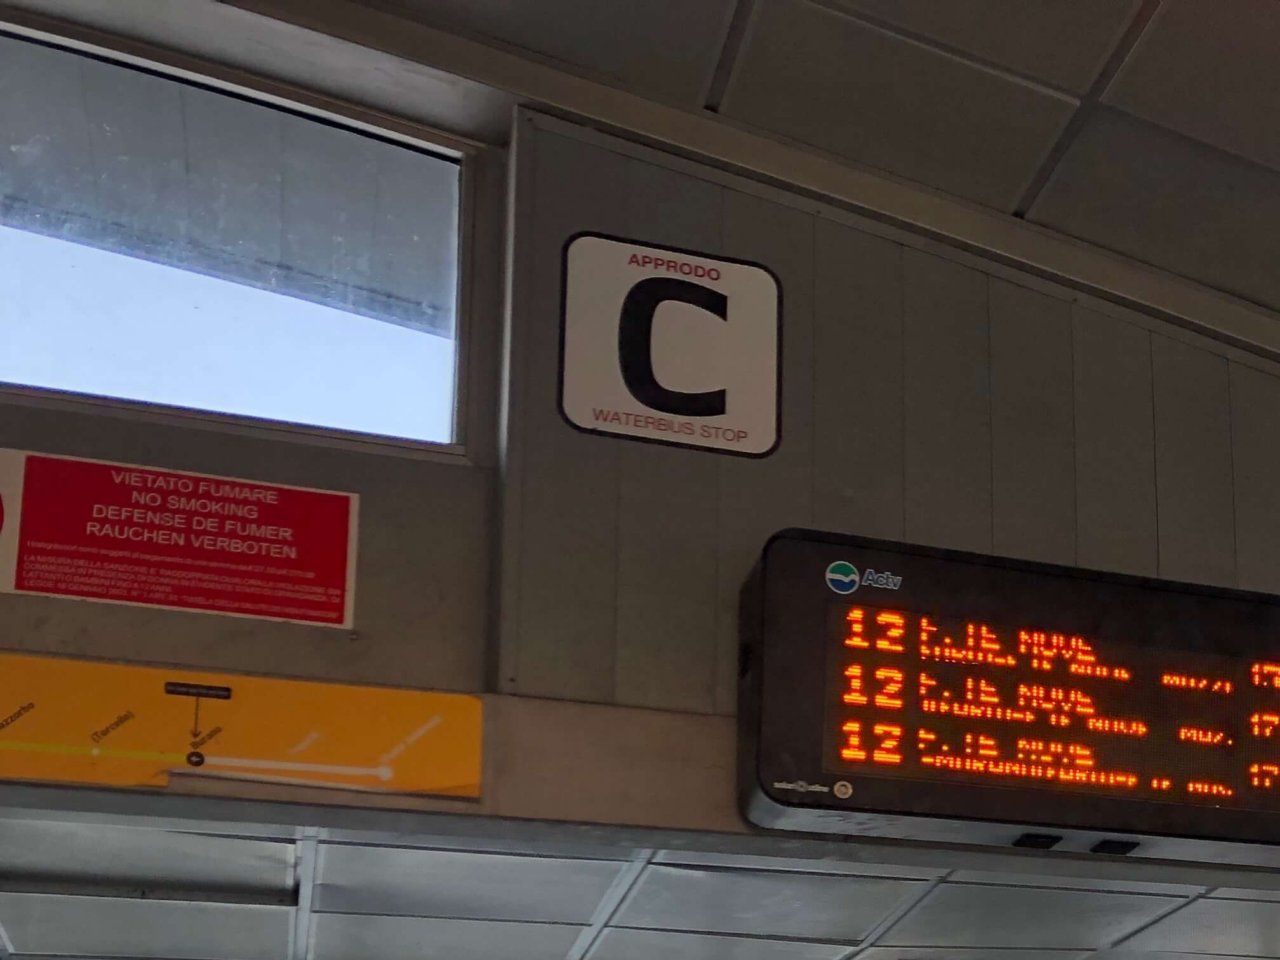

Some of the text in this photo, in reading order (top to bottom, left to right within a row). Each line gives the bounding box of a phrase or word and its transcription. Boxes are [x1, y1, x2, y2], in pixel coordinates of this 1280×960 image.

[628, 253, 721, 281] APPRODO
[618, 277, 728, 417] C
[592, 408, 748, 442] WATERBUS STOP
[111, 470, 278, 504] VIETATO FUMARE
[131, 490, 258, 519] NO SMOKING
[86, 521, 185, 546] RAUCHEN
[190, 533, 297, 559] VERBOTEN
[92, 503, 292, 541] DEFENSE DE FUMER
[845, 609, 904, 651] 12
[843, 665, 904, 708] 12
[841, 722, 902, 763] 12
